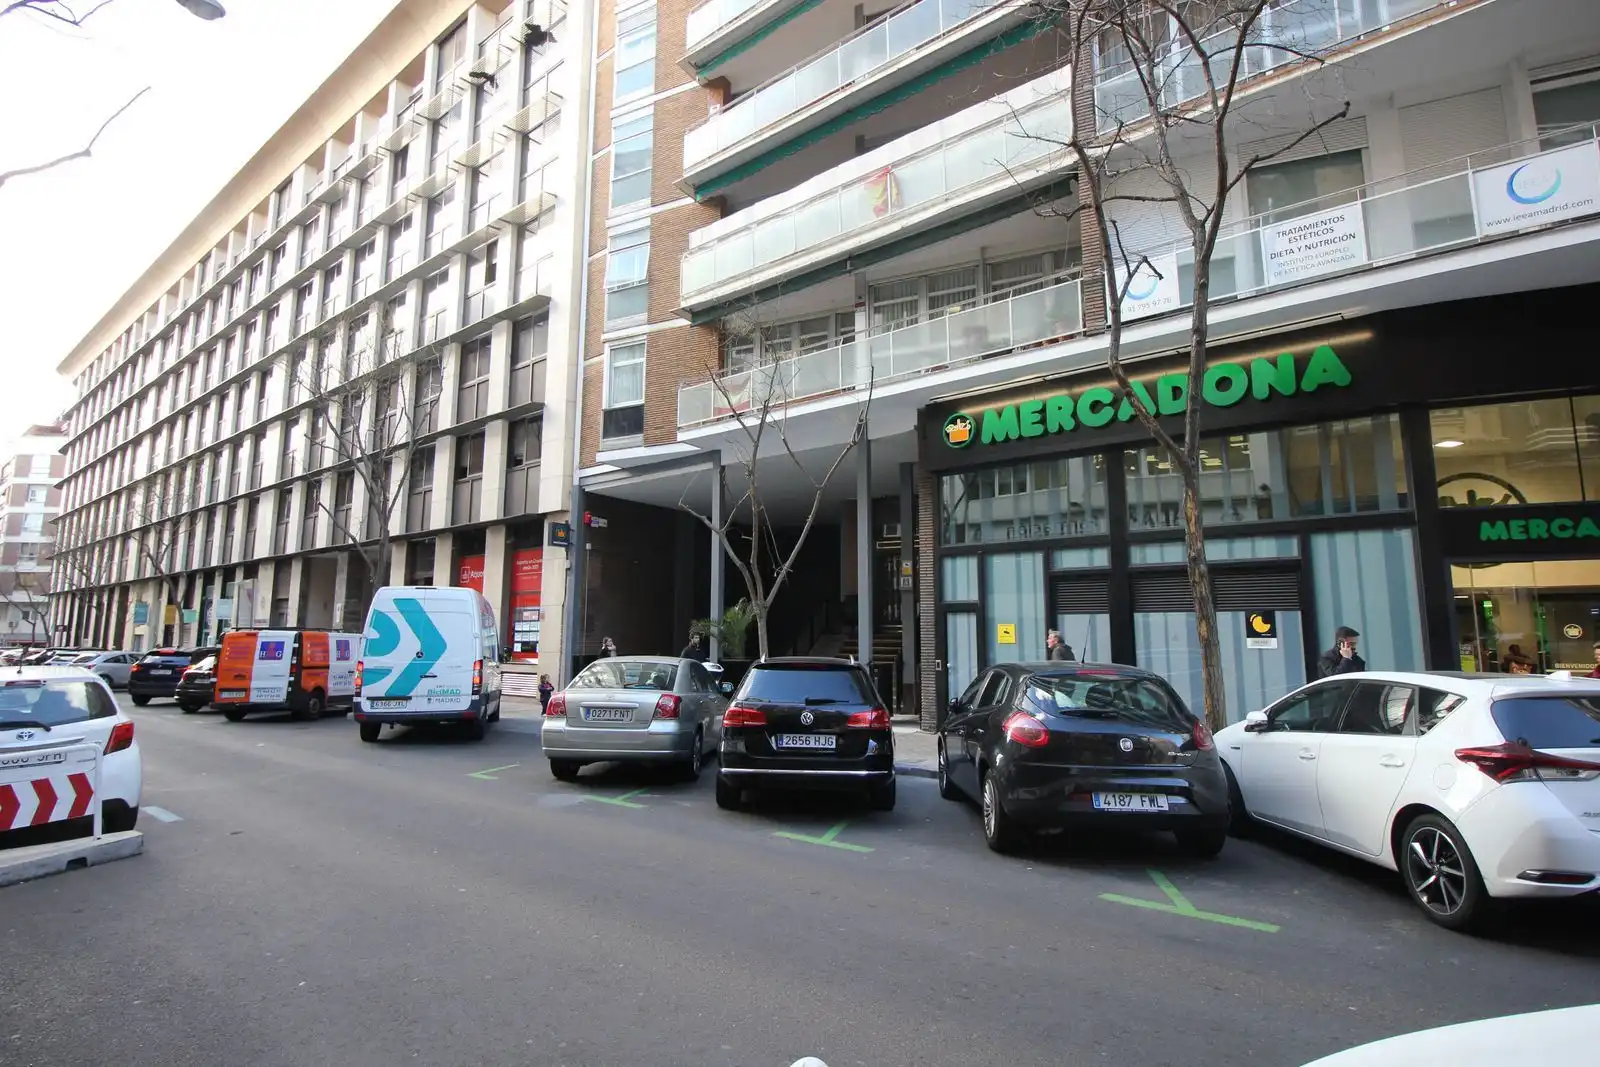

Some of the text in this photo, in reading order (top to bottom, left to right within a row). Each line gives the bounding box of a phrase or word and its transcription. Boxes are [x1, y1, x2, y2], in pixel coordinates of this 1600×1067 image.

[1485, 198, 1594, 228] www.ieeamadrid.com
[1276, 214, 1345, 238] TRATAMIENTOS
[1270, 248, 1295, 260] DIETA
[1304, 232, 1356, 251] NUTRICIÓN
[1278, 254, 1313, 268] INSTITUTO
[1316, 253, 1356, 267] AVANZADA
[979, 345, 1353, 444] MERCADONA
[591, 709, 630, 718] 0271 FNT
[785, 735, 834, 746] 2656 HJG
[1103, 793, 1165, 808] 4187 FWL
